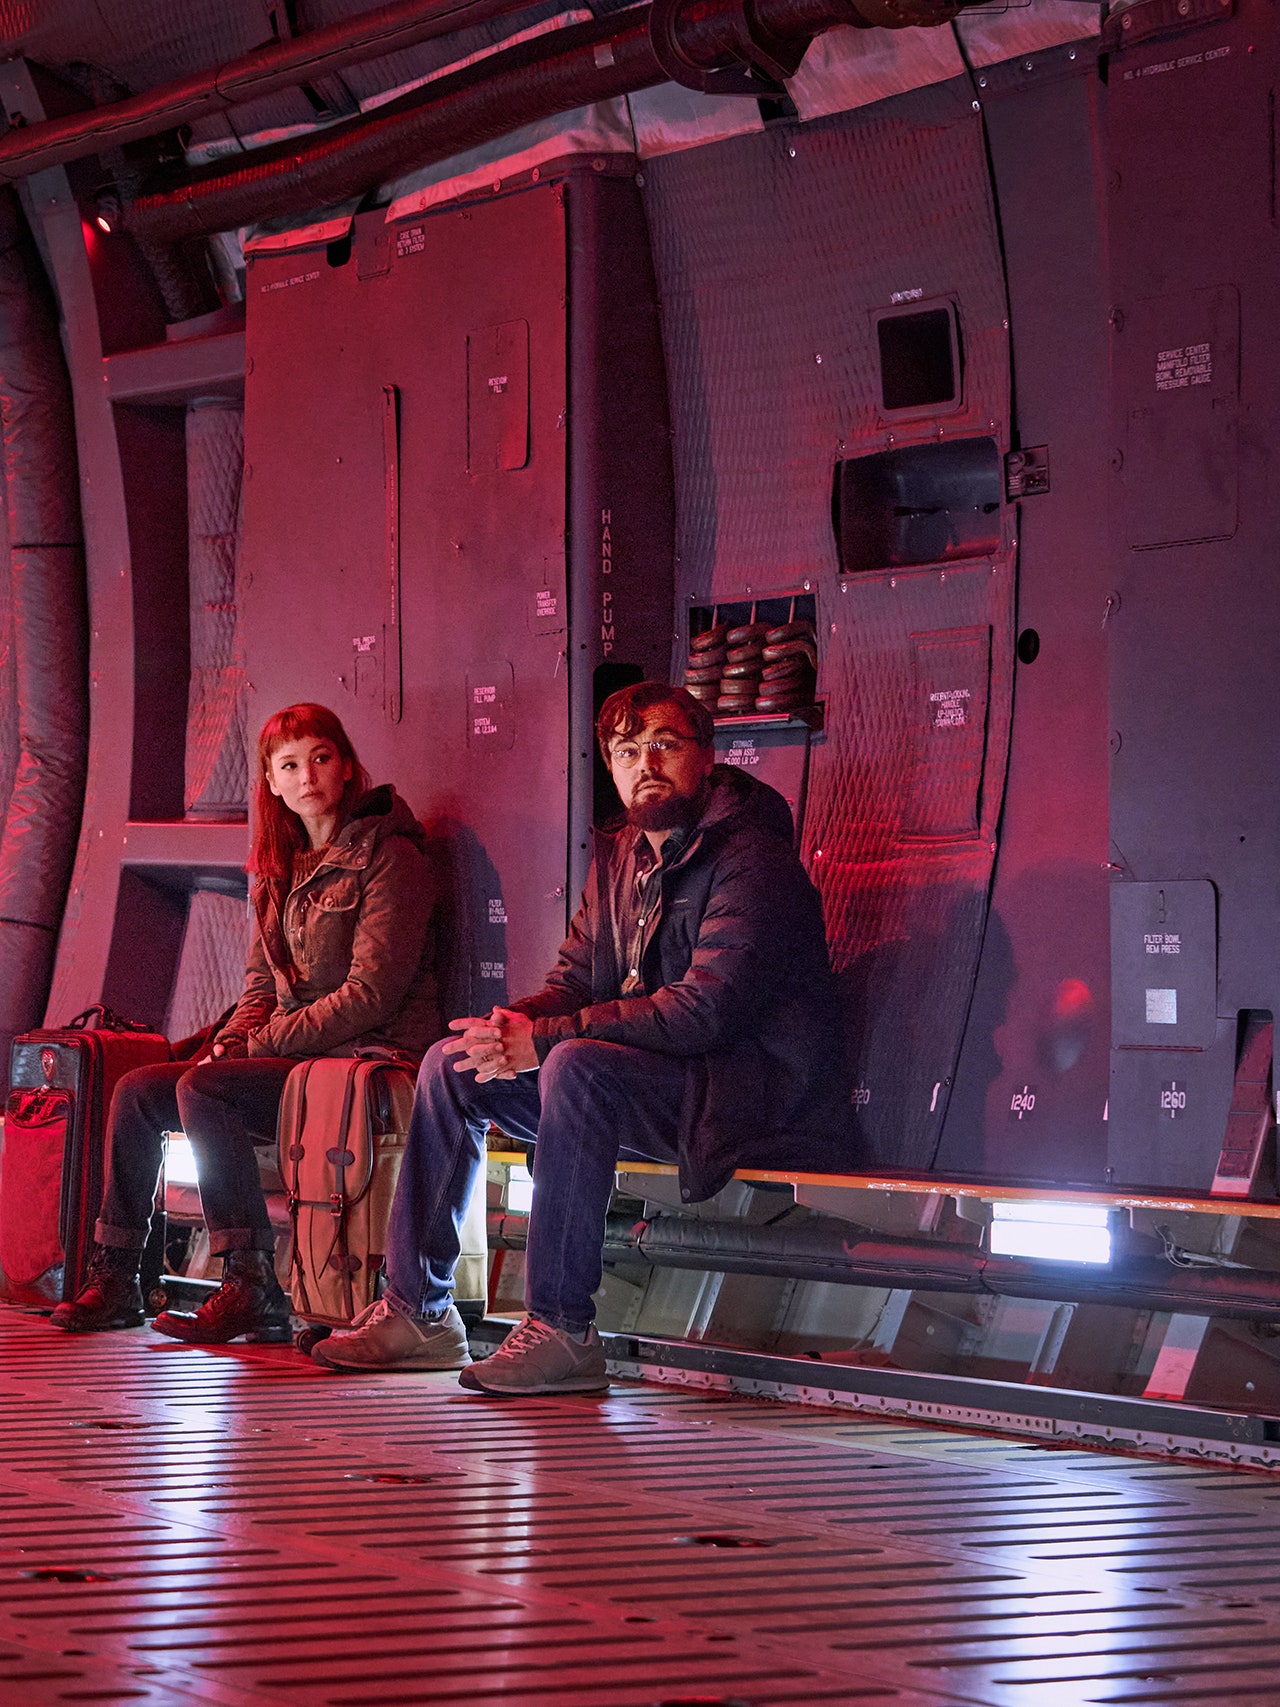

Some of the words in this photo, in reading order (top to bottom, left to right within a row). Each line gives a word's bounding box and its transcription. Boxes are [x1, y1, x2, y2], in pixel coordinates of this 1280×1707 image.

[1177, 52, 1204, 68] SERVICE
[1205, 46, 1231, 61] CENTER
[409, 242, 425, 253] SYSTEM
[412, 234, 425, 244] FILTER
[1157, 348, 1184, 362] SERVICE
[1184, 343, 1210, 356] CENTER
[1156, 357, 1189, 371] MANIFOLD
[1189, 353, 1210, 366] FILTER
[1155, 371, 1174, 382] BOWL
[1174, 362, 1213, 378] REMOVABLE
[1156, 376, 1190, 391] PRESSURE
[1190, 372, 1212, 385] GAUGE
[601, 509, 612, 575] HAND
[601, 591, 615, 658] PUMP
[728, 748, 743, 757] CHAIN
[743, 747, 757, 757] ASSY
[741, 756, 749, 765] LB
[749, 755, 760, 765] CAP
[1143, 934, 1164, 944] FILTER
[1164, 934, 1182, 944] BOWL
[1161, 944, 1181, 954] PRESS
[1010, 1094, 1036, 1111] 1240
[1160, 1091, 1186, 1109] 1260
